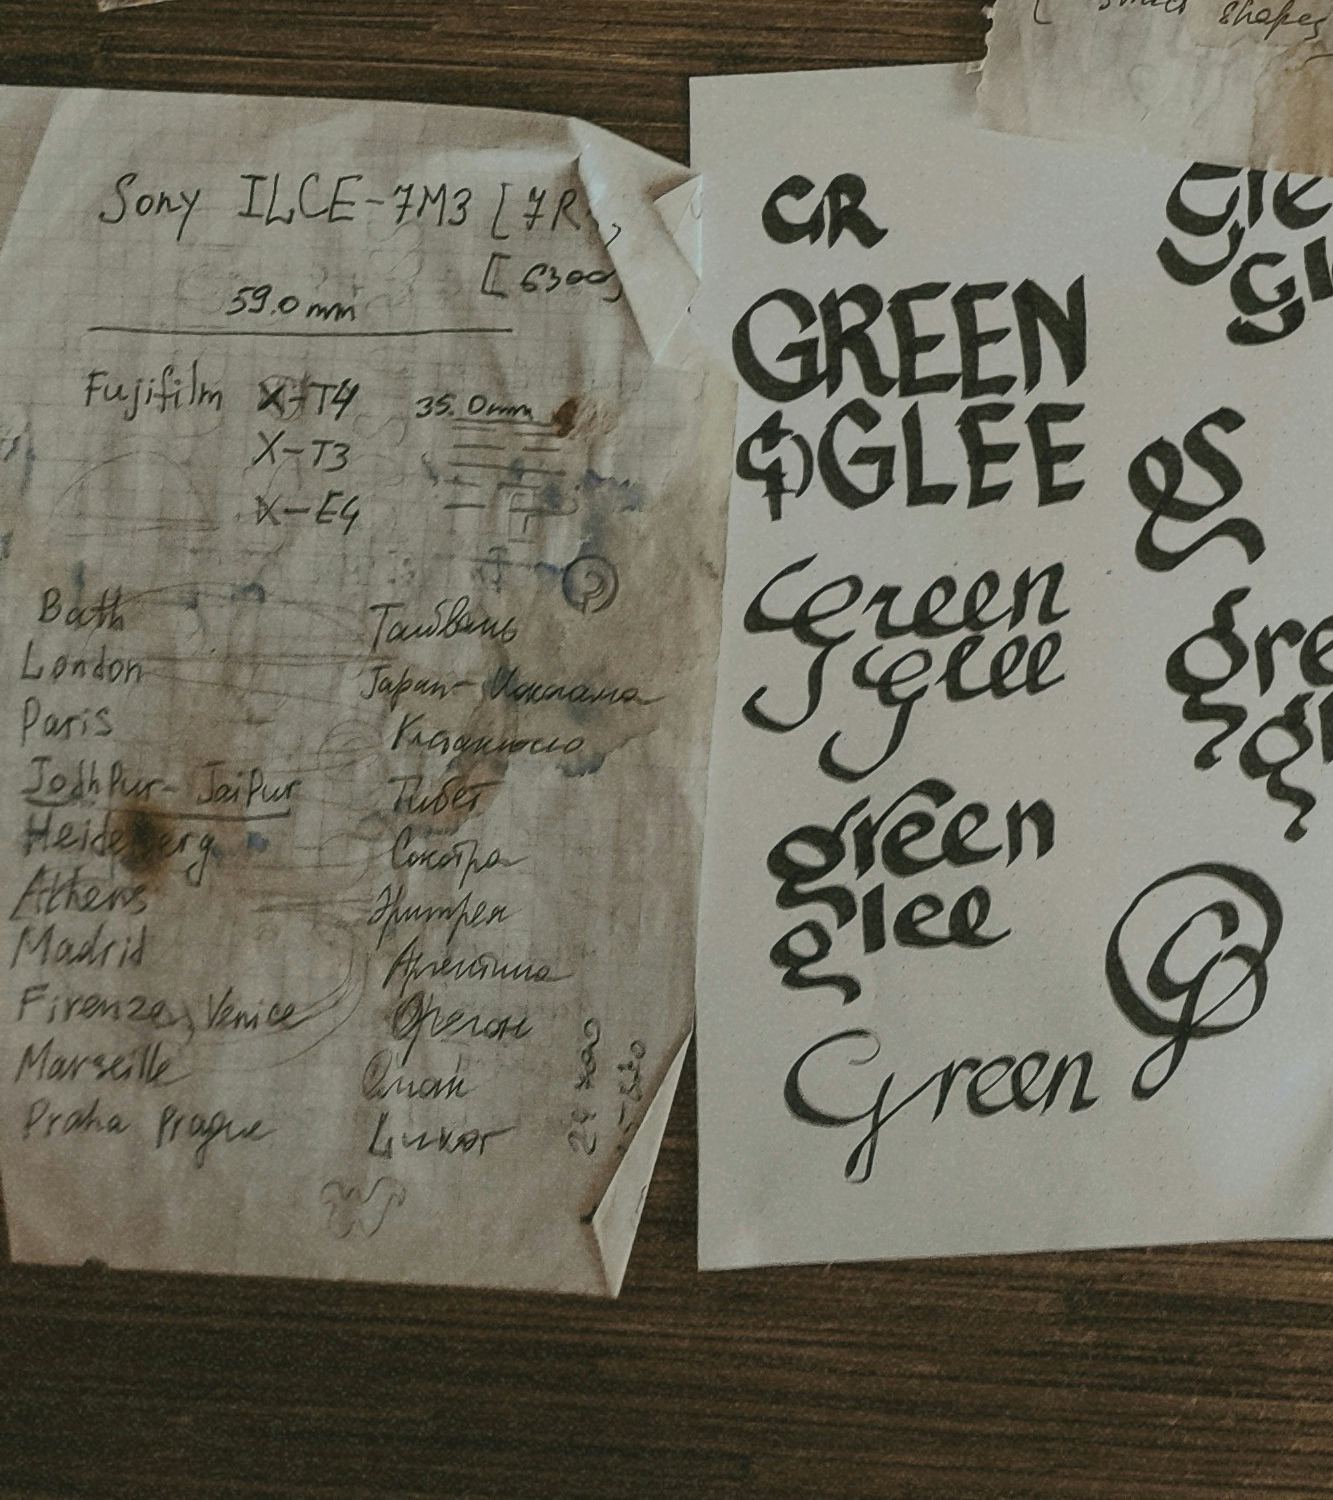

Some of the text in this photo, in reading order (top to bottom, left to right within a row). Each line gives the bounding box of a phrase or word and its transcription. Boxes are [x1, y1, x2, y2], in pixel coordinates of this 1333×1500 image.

[99, 172, 473, 243] Sony ILCE-7M3
[731, 275, 1088, 405] GREEN
[83, 361, 226, 423] Fujifilm
[252, 430, 351, 473] X-T3
[254, 493, 361, 536] X-E4
[36, 588, 129, 633] Bath
[20, 640, 146, 685] London
[20, 699, 115, 747] Paris
[22, 809, 216, 888] Heideerg
[765, 778, 1057, 930] green
[8, 863, 149, 921] Athens
[8, 920, 148, 971] Madrid
[769, 884, 1013, 1006] glee
[206, 987, 303, 1032] Venice
[783, 1028, 1101, 1186] Green
[155, 1106, 280, 1169] Prague
